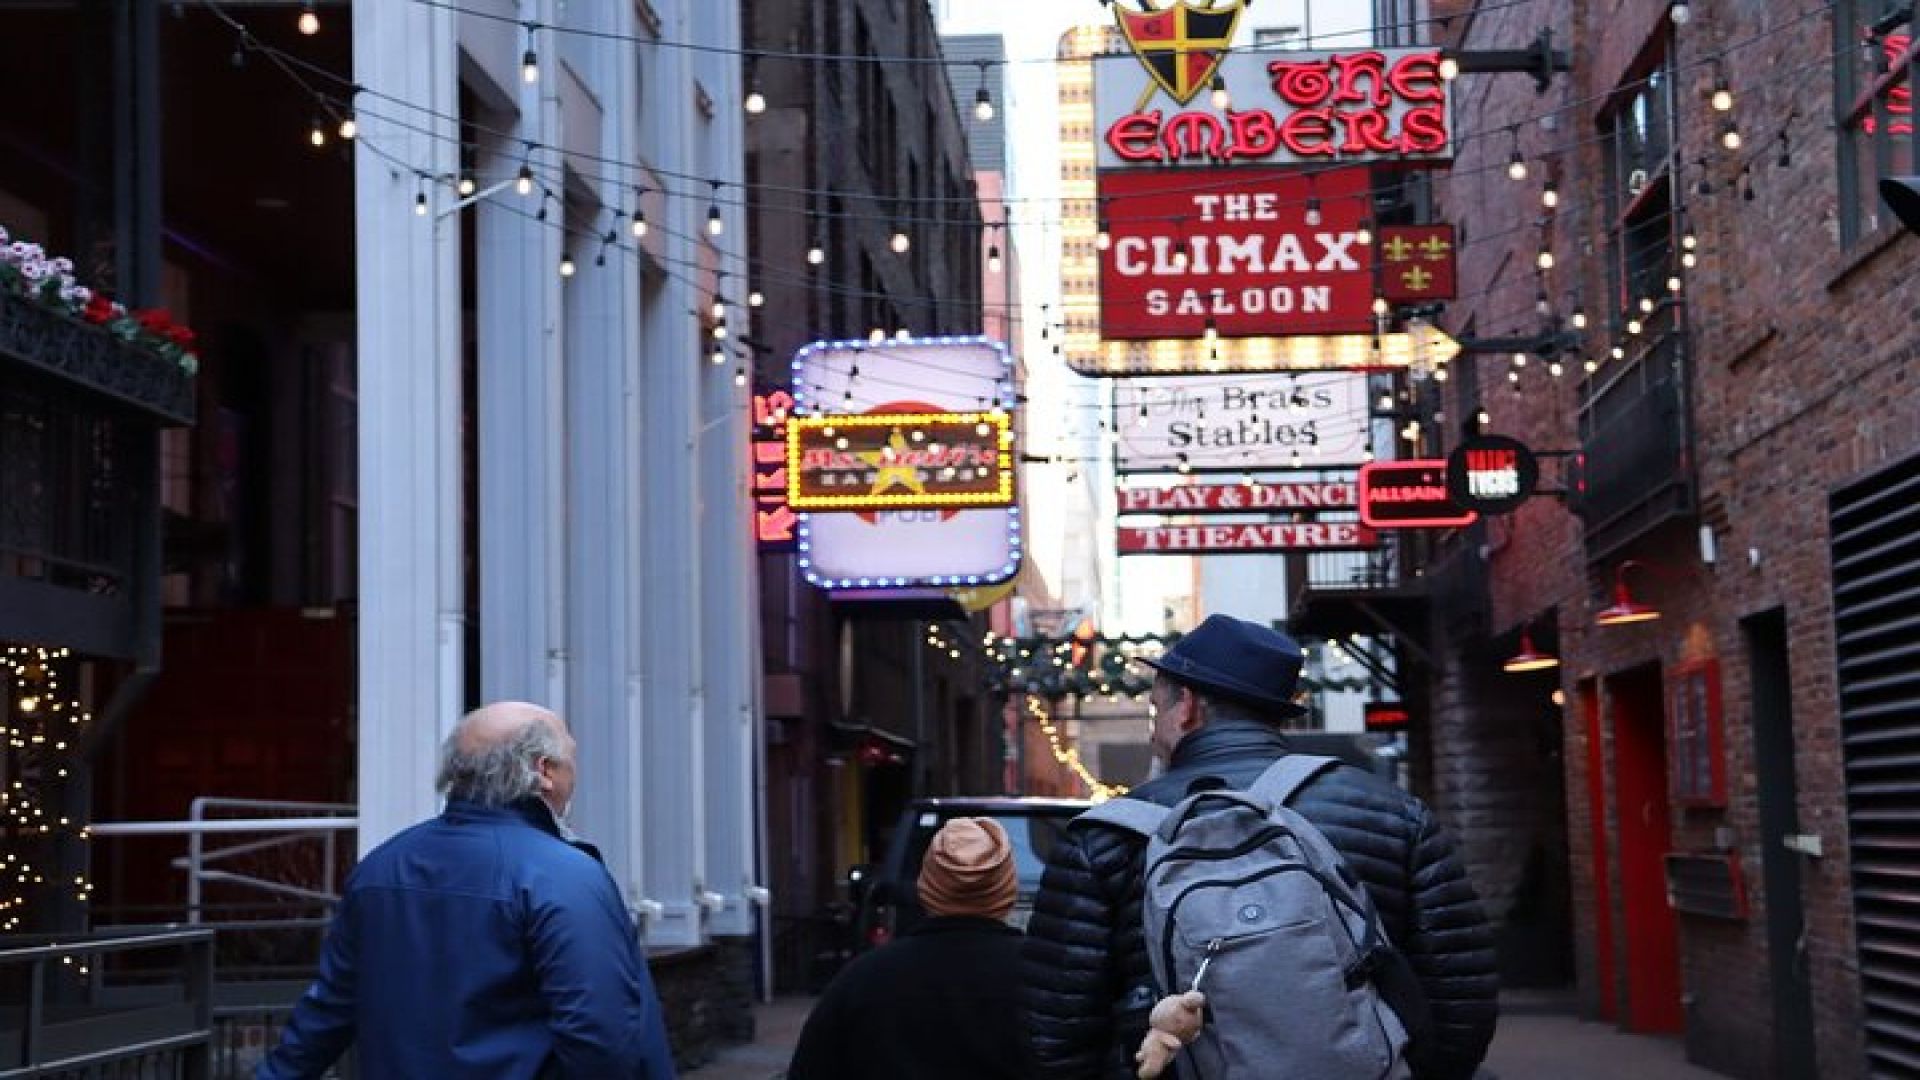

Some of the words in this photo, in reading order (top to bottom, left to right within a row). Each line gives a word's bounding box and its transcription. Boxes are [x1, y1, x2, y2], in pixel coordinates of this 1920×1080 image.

[1105, 105, 1447, 162] EMBERS
[1193, 193, 1278, 222] THE
[1115, 233, 1360, 276] CLIMAX
[1146, 286, 1331, 315] SALOON
[1223, 385, 1332, 410] Brass
[1167, 420, 1319, 448] Stables
[1124, 485, 1212, 508] PLAY
[1218, 485, 1243, 508] &
[1136, 524, 1359, 549] THEATRE
